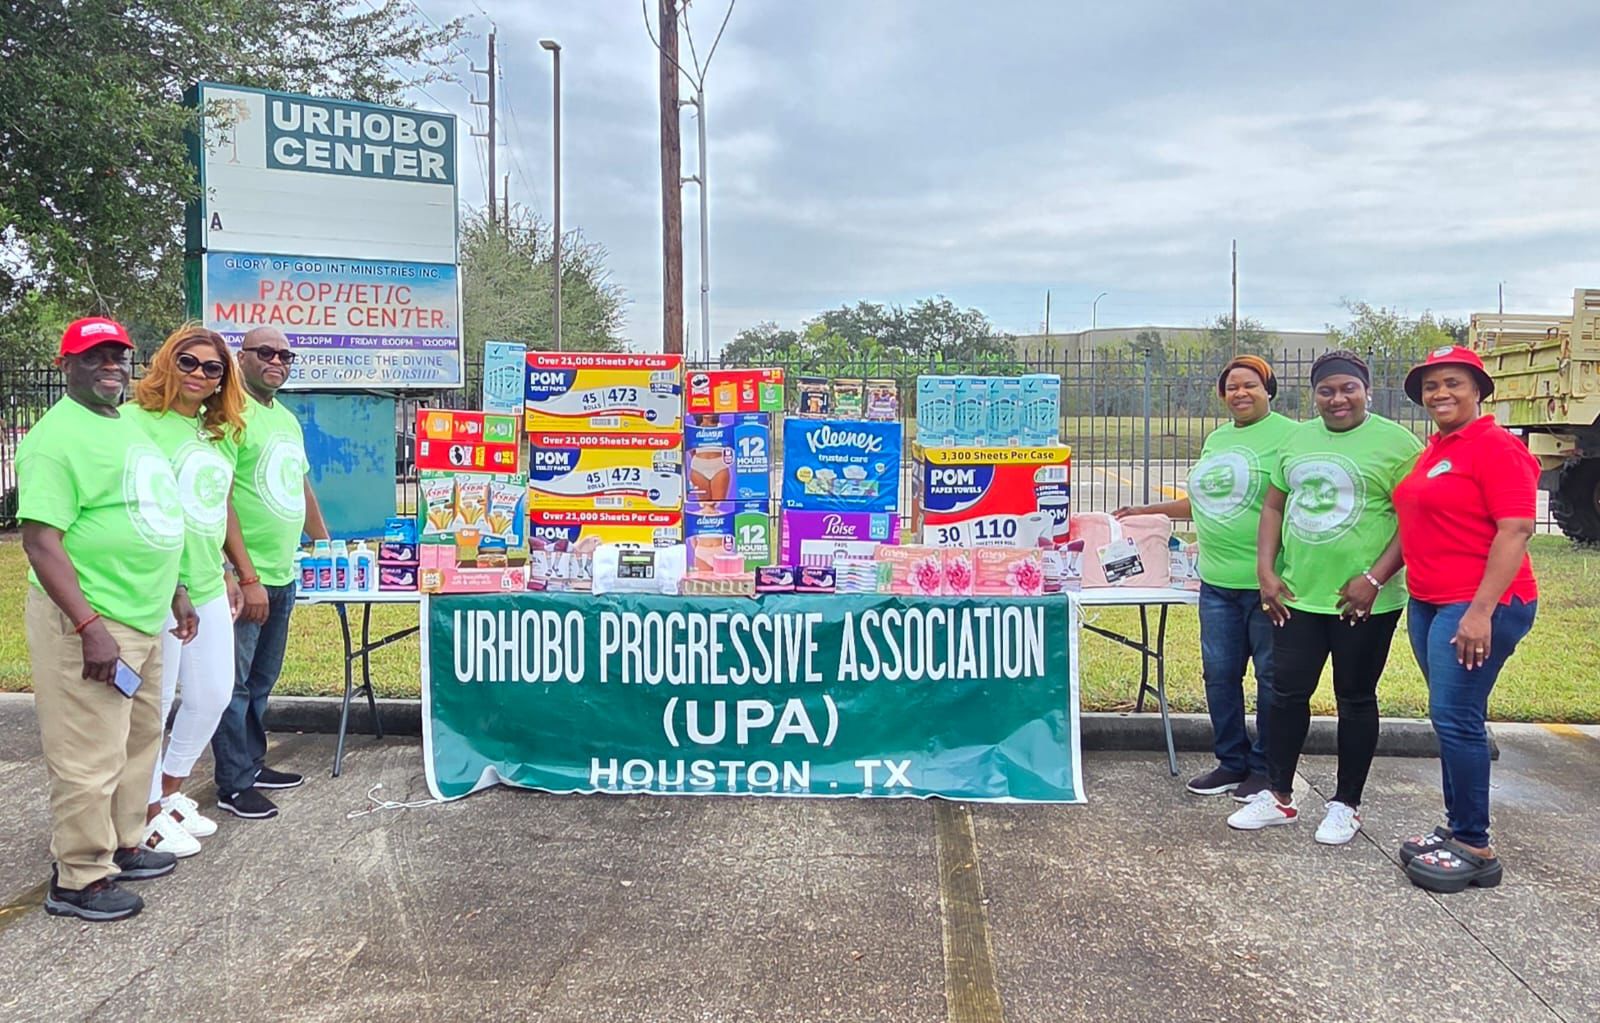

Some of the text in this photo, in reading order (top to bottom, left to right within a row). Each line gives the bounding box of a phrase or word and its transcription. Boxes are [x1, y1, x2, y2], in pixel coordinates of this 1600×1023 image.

[272, 101, 446, 147] URHOBO
[273, 137, 446, 180] CENTER
[210, 212, 223, 230] A
[225, 258, 267, 269] GLORY
[273, 261, 289, 270] OF
[294, 262, 322, 272] GOD
[327, 263, 345, 274] INT
[351, 264, 415, 277] MINISTRIES
[259, 280, 411, 304] PROPHETIC
[215, 303, 337, 326] MIRACLE
[296, 336, 332, 345] 12:30PM
[350, 337, 377, 346] FRIDAY
[294, 354, 443, 366] EXPERIENCE THE DIVINE
[538, 356, 666, 366] Over 21,000 Sheets Per Case
[311, 369, 328, 379] OF
[334, 369, 363, 379] GOD
[381, 369, 440, 380] WORSHIP
[530, 372, 564, 385] POM
[582, 388, 637, 404] 45 473
[543, 436, 669, 446] Over 21,000 Sheets Per Case
[738, 436, 765, 457] 12
[806, 425, 883, 453] Kleenex
[535, 452, 568, 464] POM
[819, 454, 868, 463] trusted care
[941, 450, 1054, 461] 3,300 Sheets Per Case
[586, 472, 601, 484] 45
[612, 468, 641, 481] 473
[930, 468, 975, 486] POM
[543, 512, 669, 522] Over 21,000 Sheets Per Case
[822, 514, 856, 534] Poise
[535, 527, 568, 539] POM
[740, 525, 766, 544] 12
[938, 518, 1017, 544] 30 110
[453, 606, 1045, 685] URHOBO PROGRESSIVE ASSOCIATION
[662, 694, 839, 747] (UPA)
[588, 757, 810, 788] HOUSTON
[854, 759, 913, 788] TX
